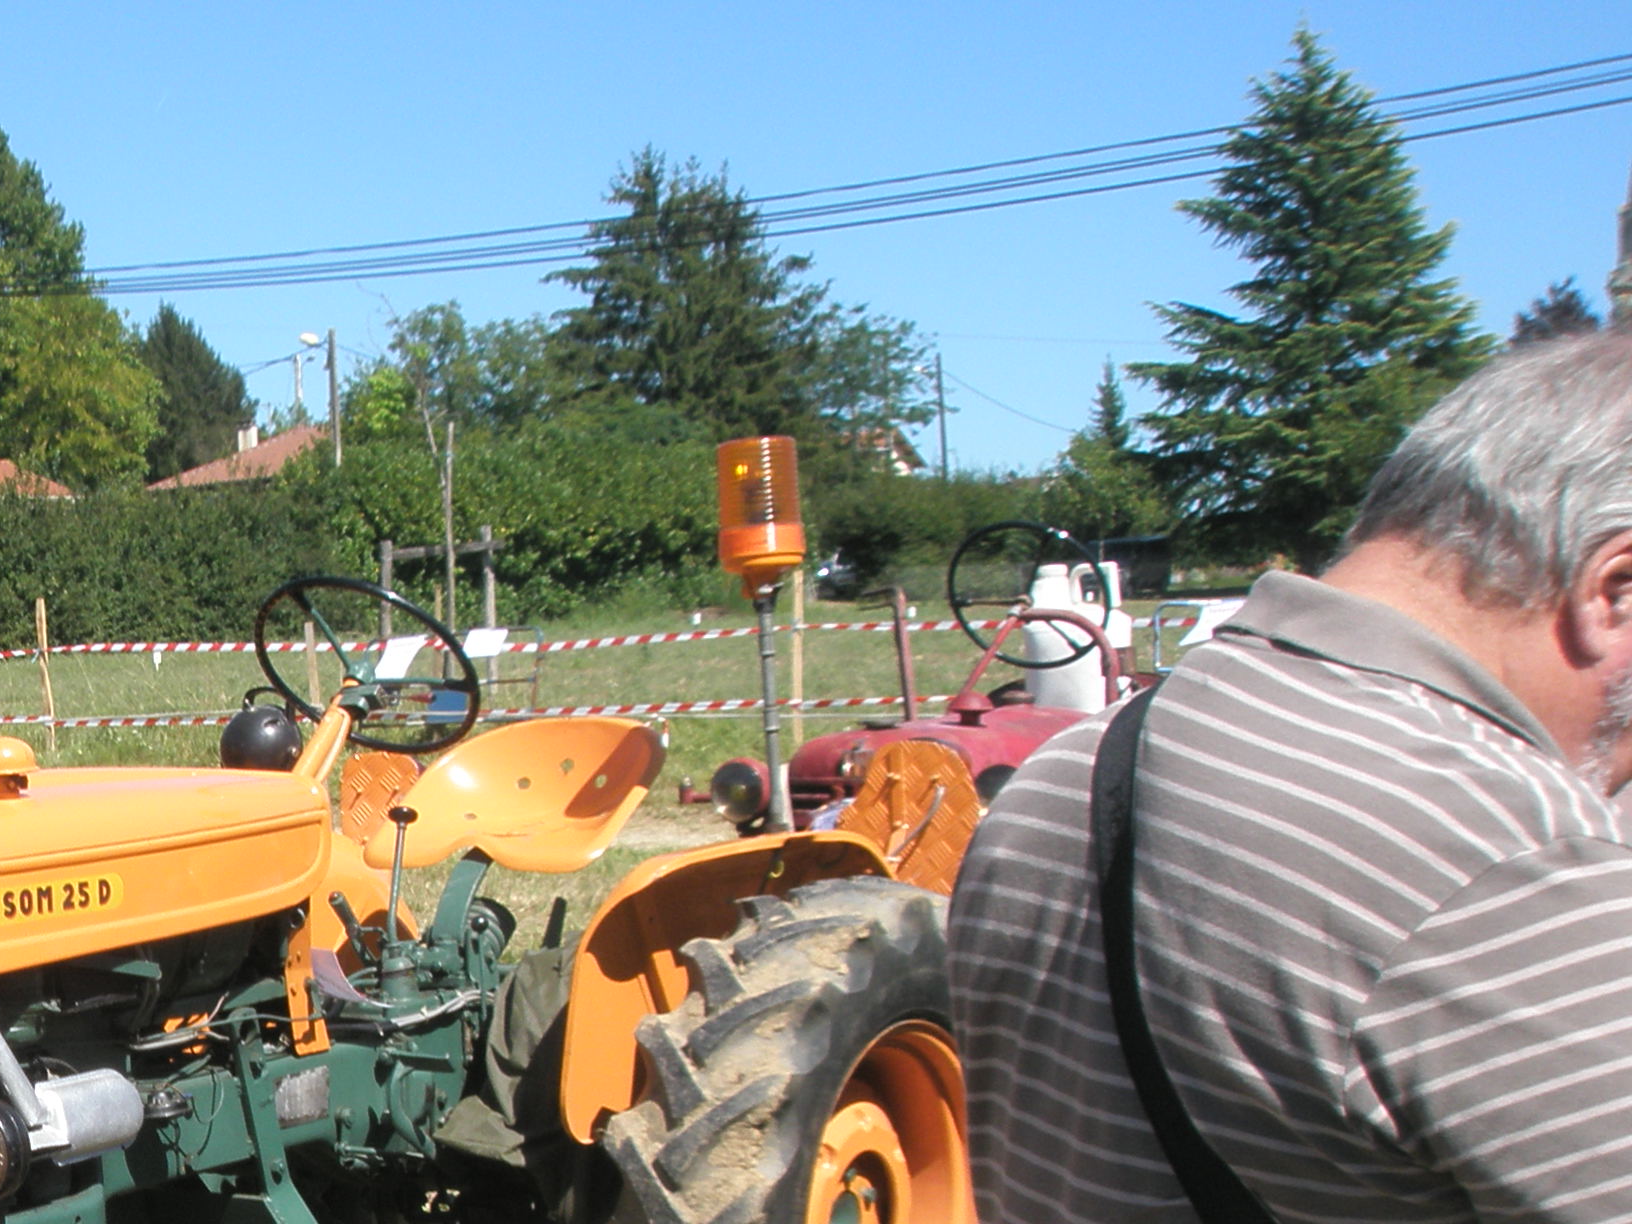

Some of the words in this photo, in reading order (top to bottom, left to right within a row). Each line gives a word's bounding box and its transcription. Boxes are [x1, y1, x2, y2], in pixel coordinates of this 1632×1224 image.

[3, 886, 53, 919] SOM
[62, 881, 90, 911] 25
[98, 879, 111, 906] D
